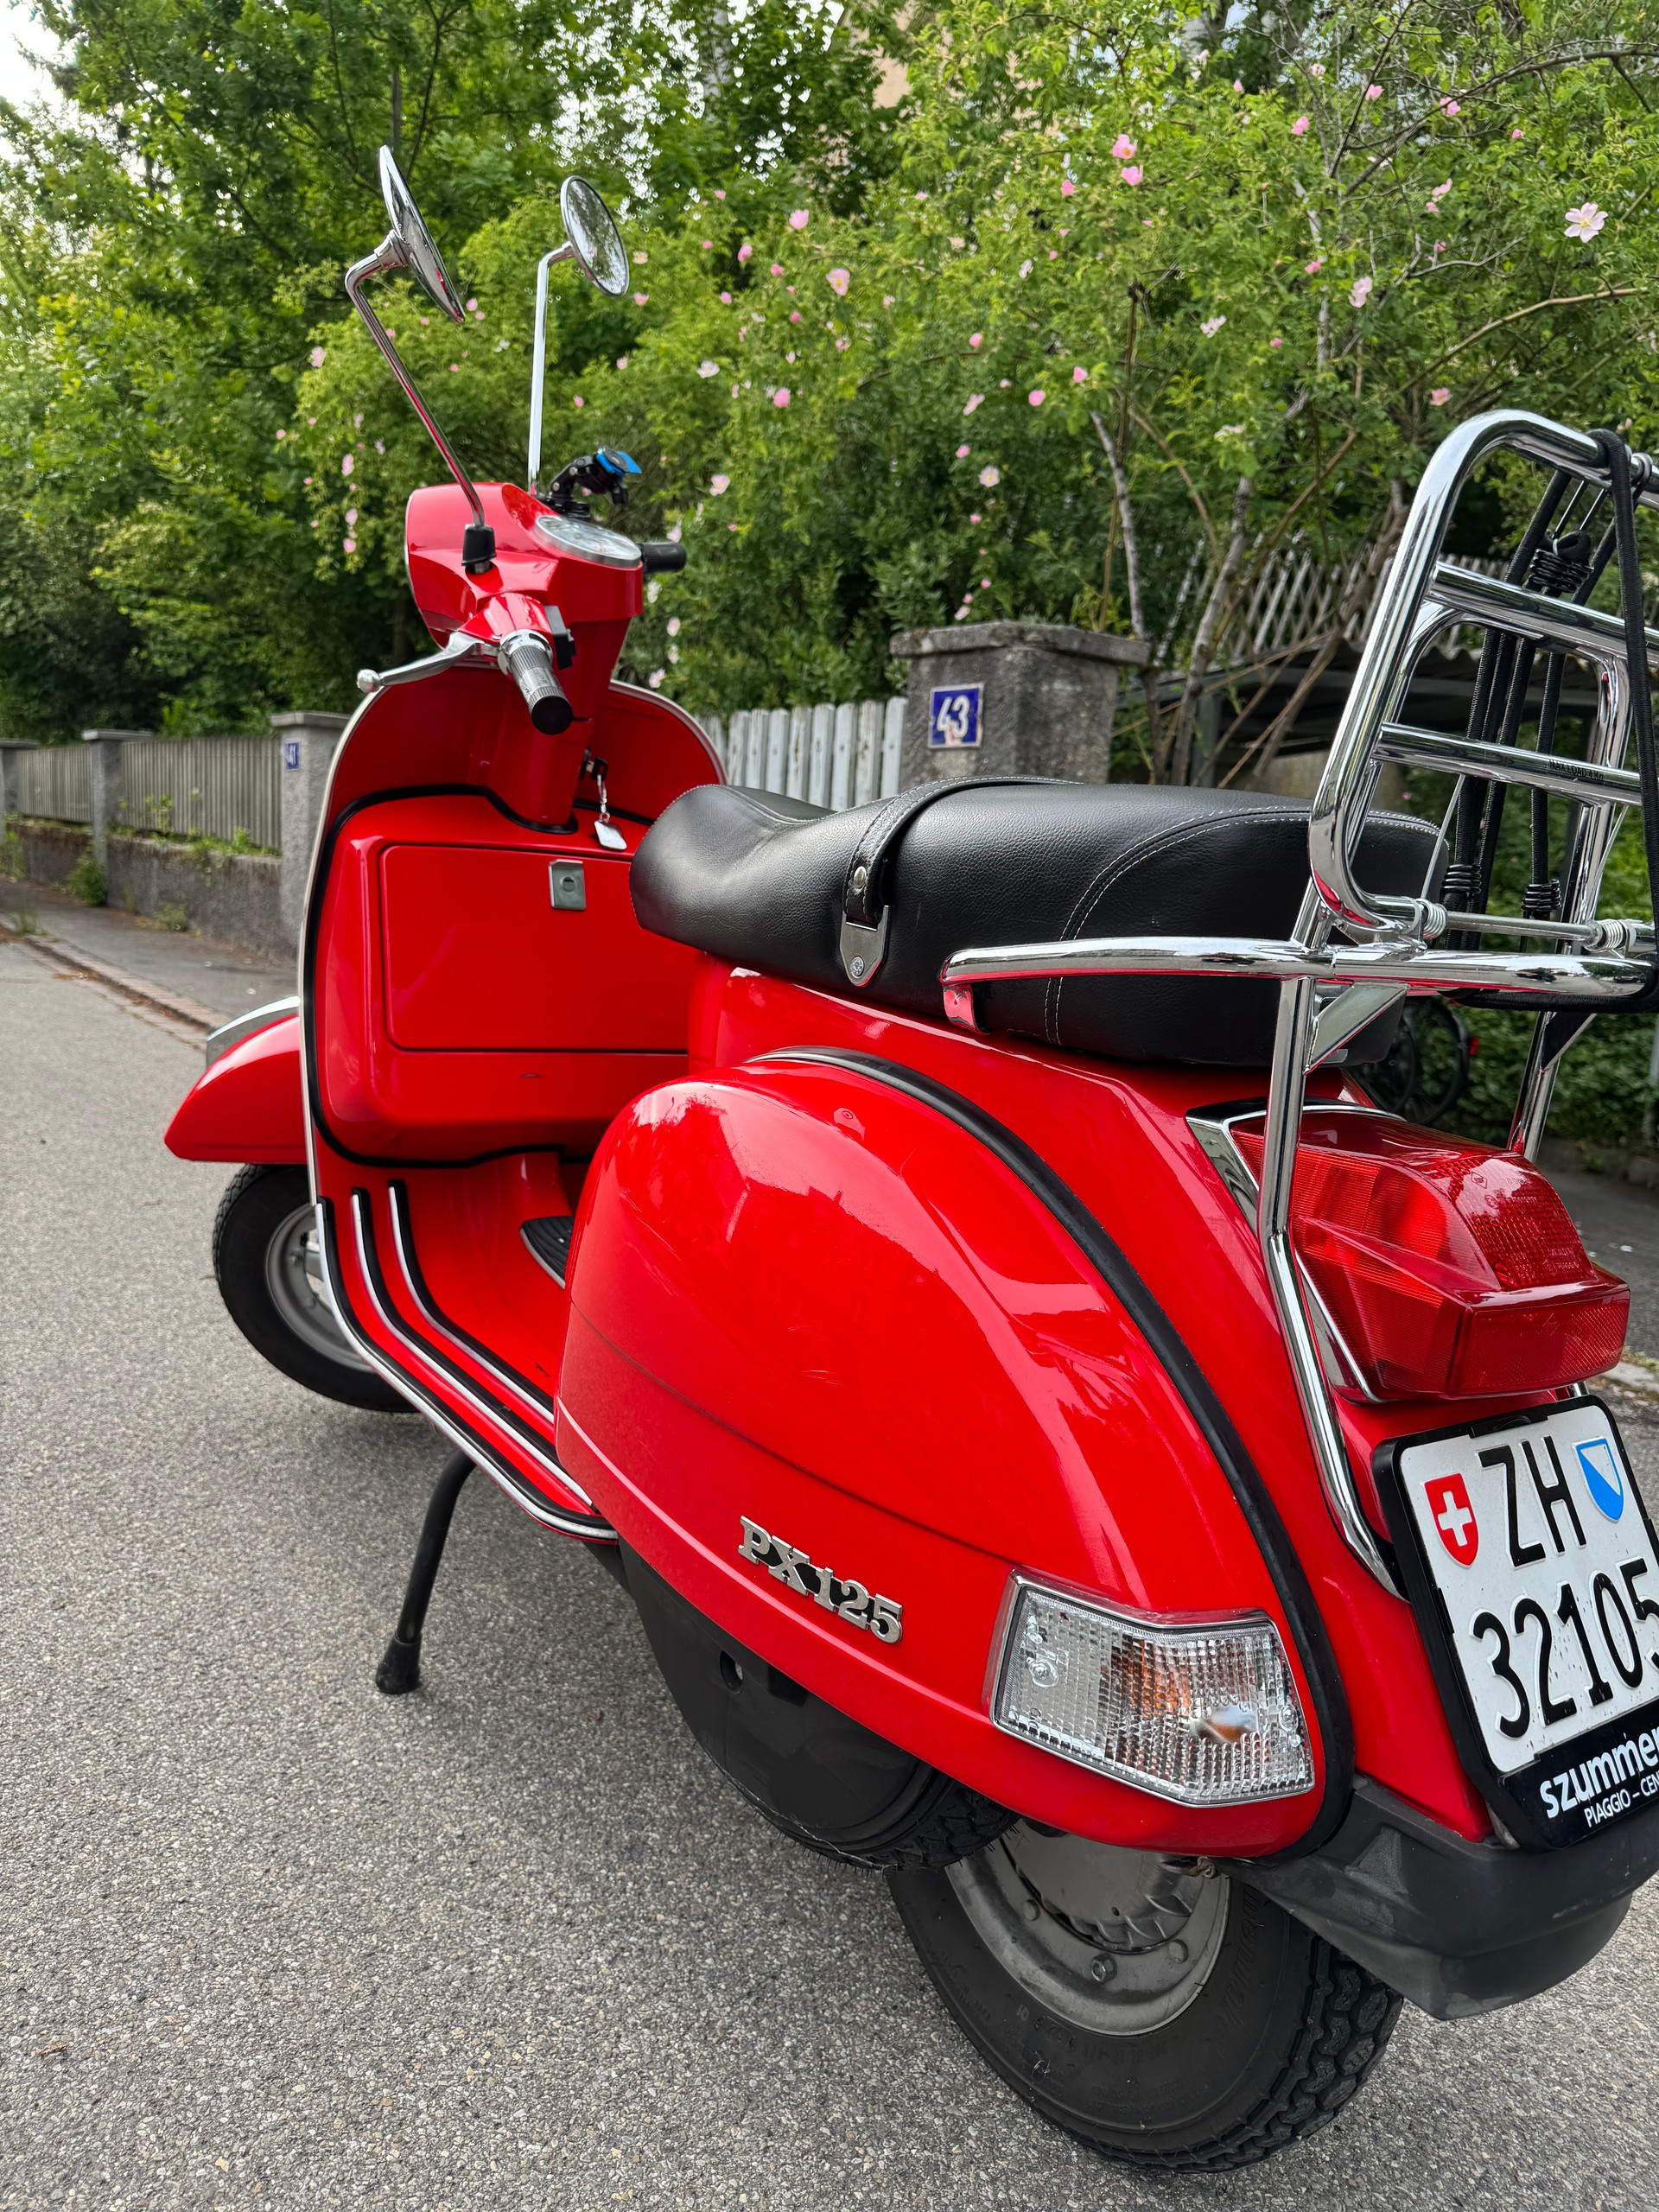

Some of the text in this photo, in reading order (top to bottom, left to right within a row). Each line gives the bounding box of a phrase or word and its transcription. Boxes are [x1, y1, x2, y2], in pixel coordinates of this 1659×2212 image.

[937, 695, 969, 739] 43
[1478, 1435, 1586, 1567] ZH
[738, 1515, 903, 1644] PX125
[1472, 1557, 1659, 1738] 32105
[1584, 1789, 1631, 1828] PIAGGIO
